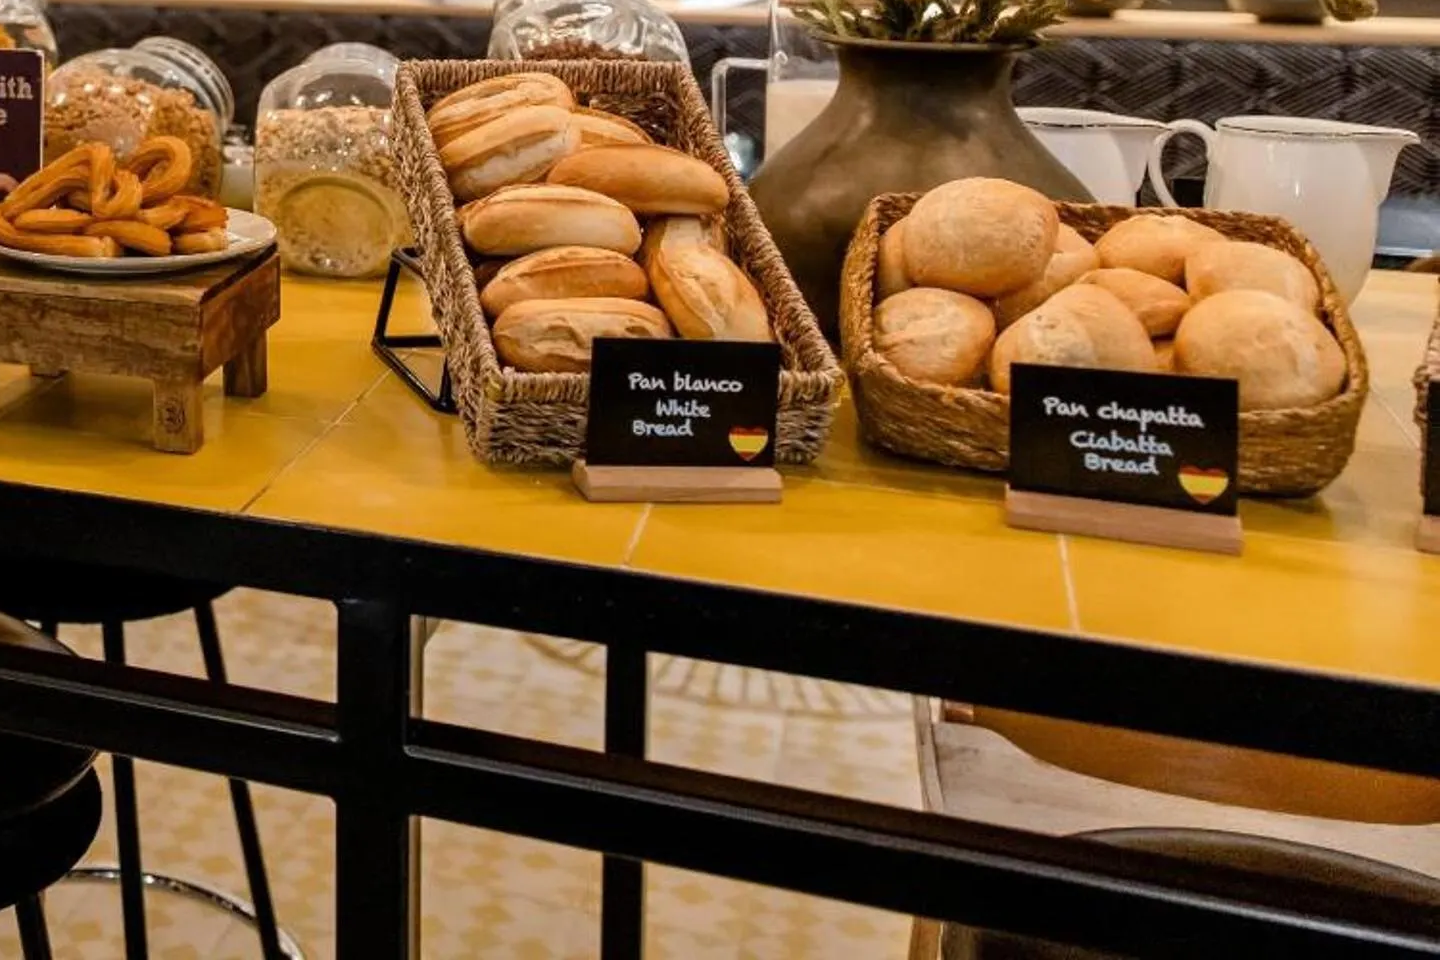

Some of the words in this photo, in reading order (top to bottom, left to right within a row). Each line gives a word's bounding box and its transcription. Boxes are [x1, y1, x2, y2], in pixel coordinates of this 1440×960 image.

[628, 372, 667, 391] Pan
[673, 370, 744, 393] blanco
[656, 399, 712, 418] White
[1043, 396, 1089, 418] Pan
[1097, 401, 1205, 432] chapatta
[632, 419, 694, 437] Bread
[1069, 430, 1174, 457] Ciabatta
[1084, 452, 1159, 476] Bread
